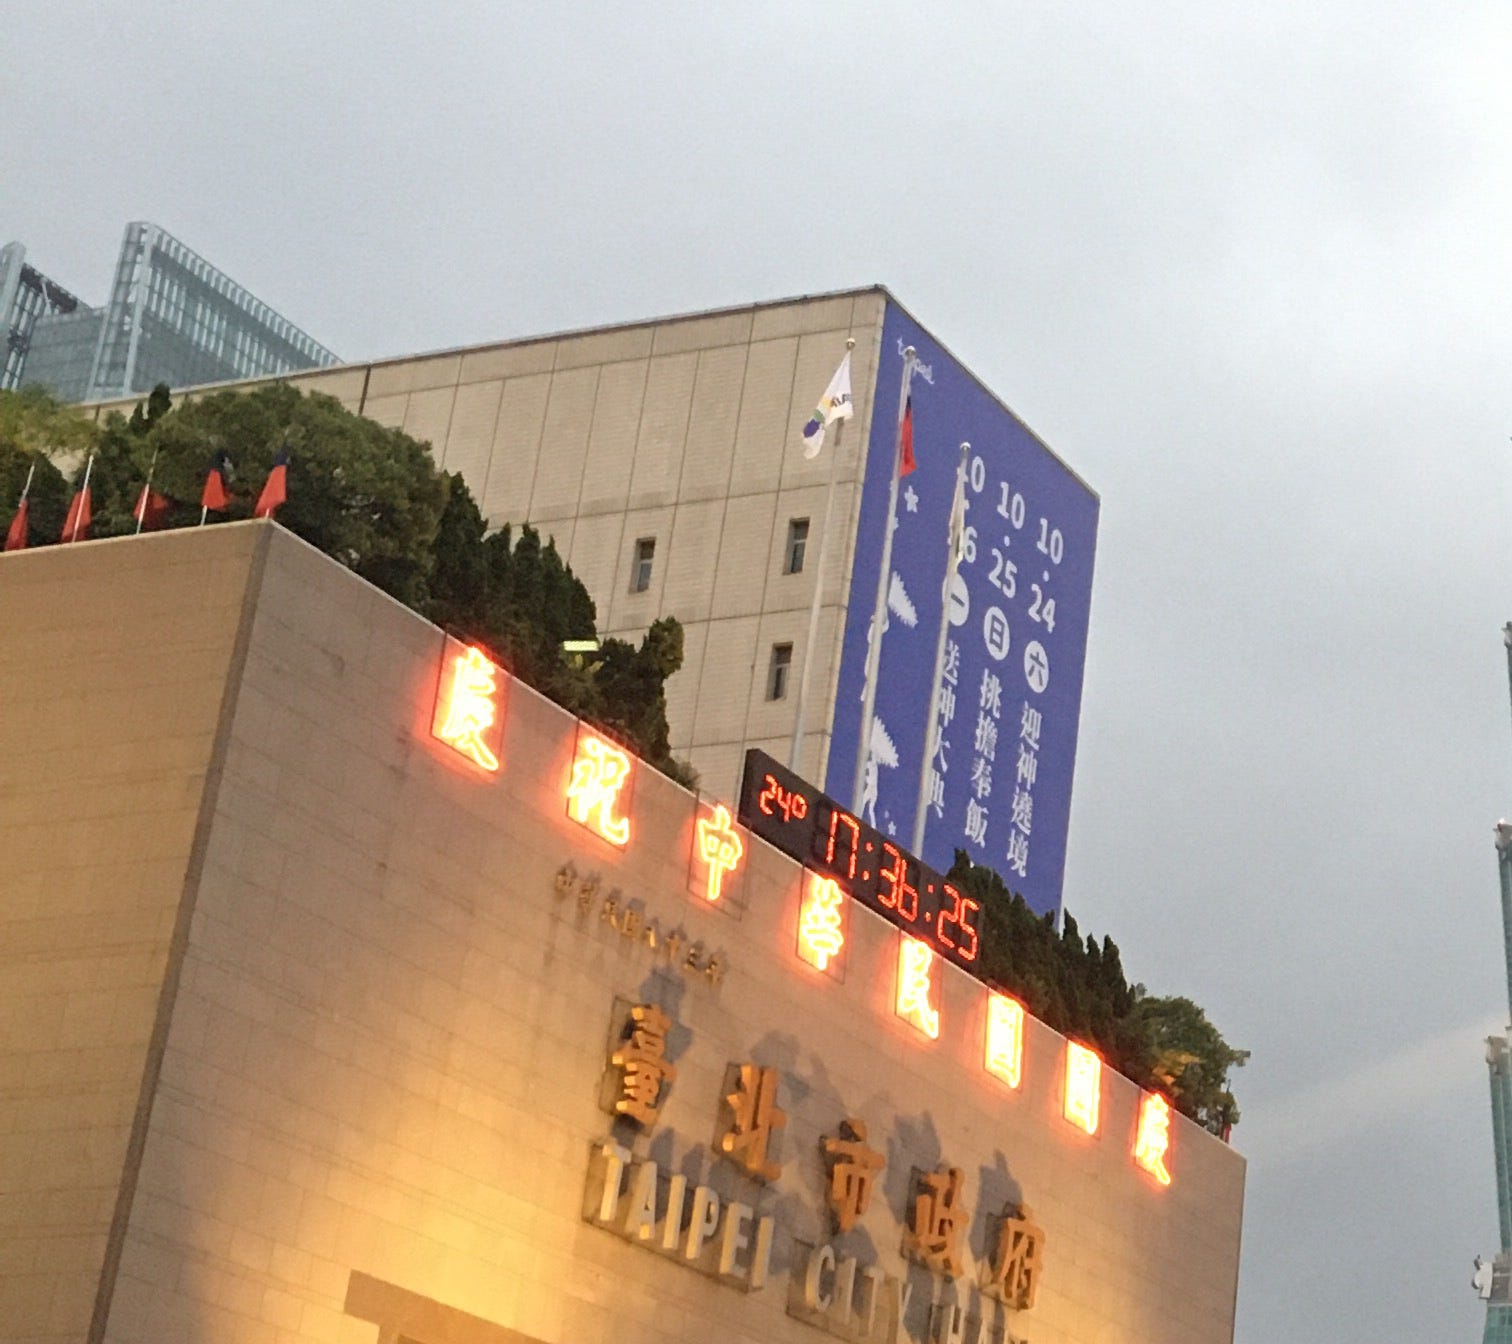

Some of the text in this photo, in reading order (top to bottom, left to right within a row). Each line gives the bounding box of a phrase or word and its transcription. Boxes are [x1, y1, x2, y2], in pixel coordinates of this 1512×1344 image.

[964, 667, 1003, 848] 挑擔奉飯
[597, 1142, 776, 1291] TAIPEI
[612, 1003, 1045, 1311] 臺北市政府
